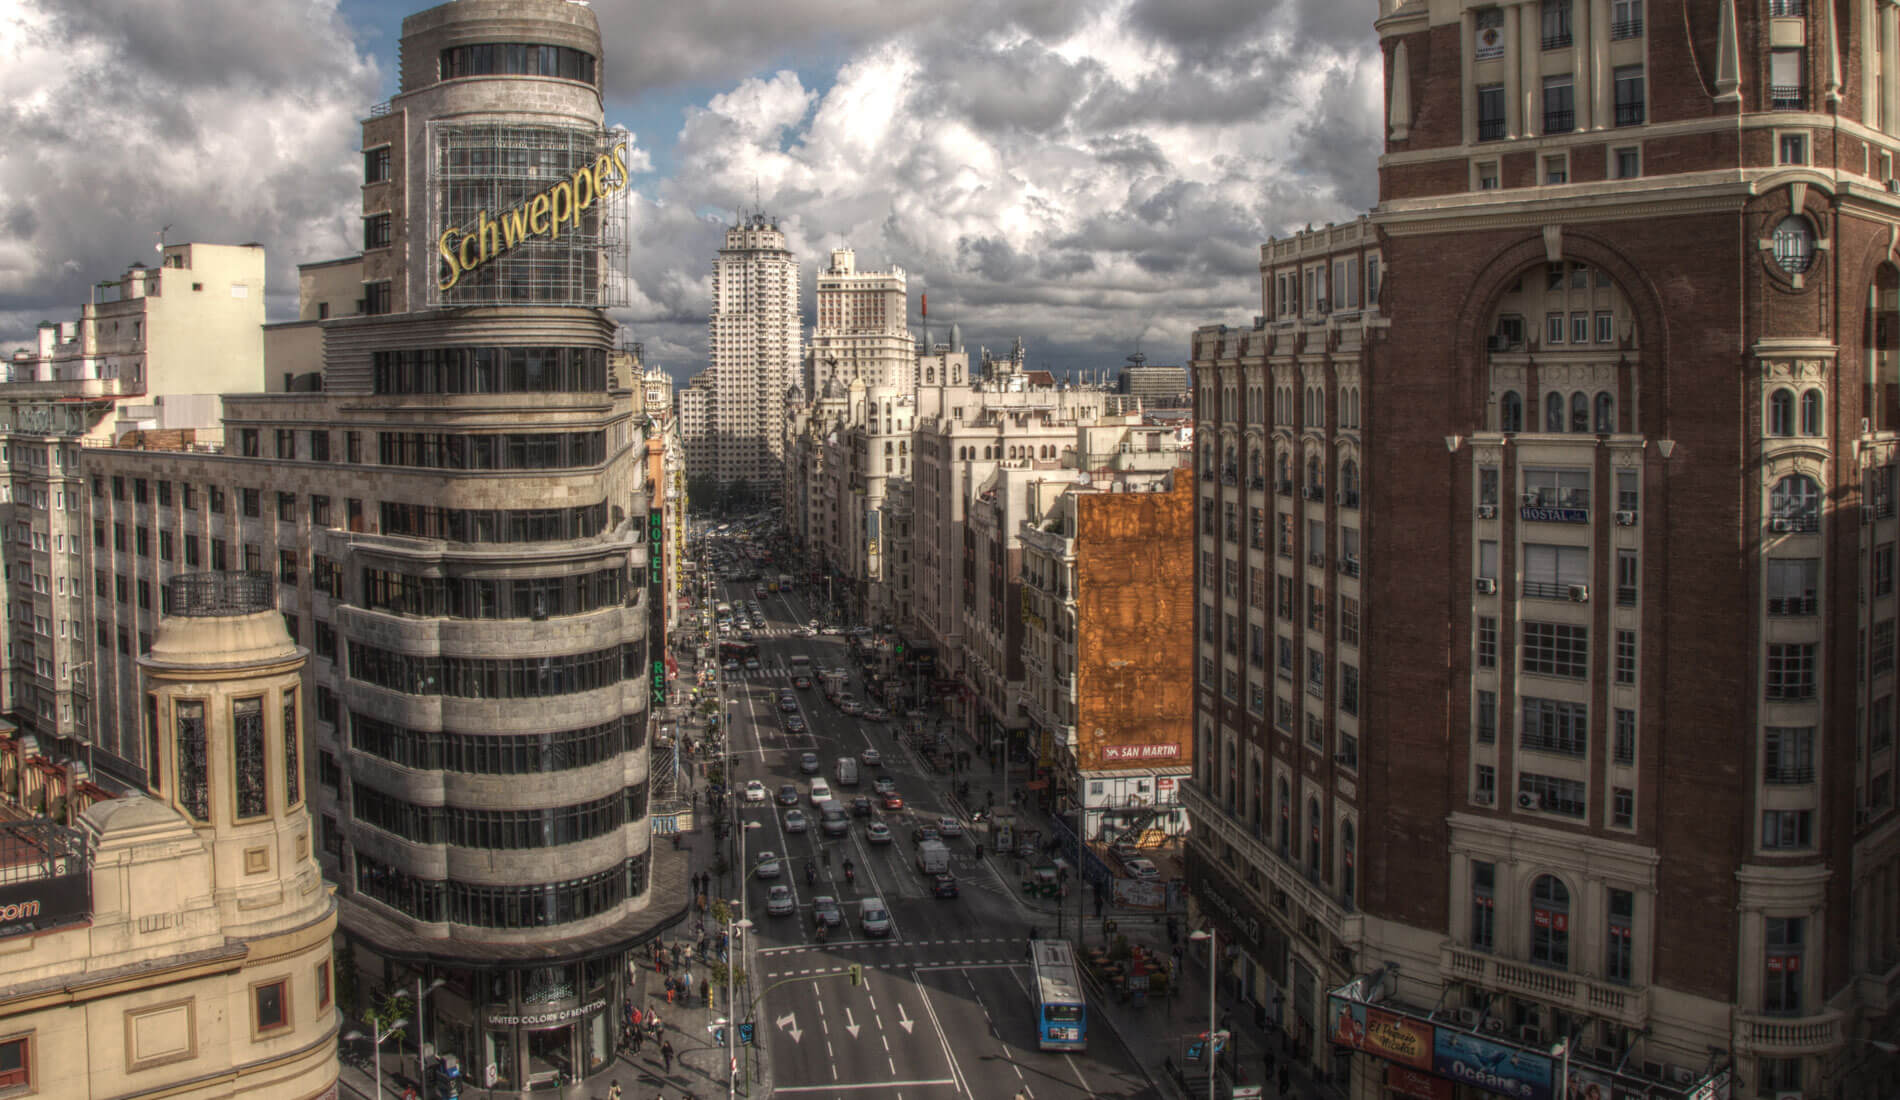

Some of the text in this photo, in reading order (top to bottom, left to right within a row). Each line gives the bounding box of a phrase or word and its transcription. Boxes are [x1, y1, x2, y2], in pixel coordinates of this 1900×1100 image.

[439, 143, 628, 291] Schweppes
[1522, 507, 1567, 521] HOSTAL
[651, 513, 661, 583] HOTEL
[653, 661, 663, 702] REX
[1121, 744, 1176, 757] SAN MARTIN
[488, 999, 606, 1025] UNITED COLORS OF BENETTON
